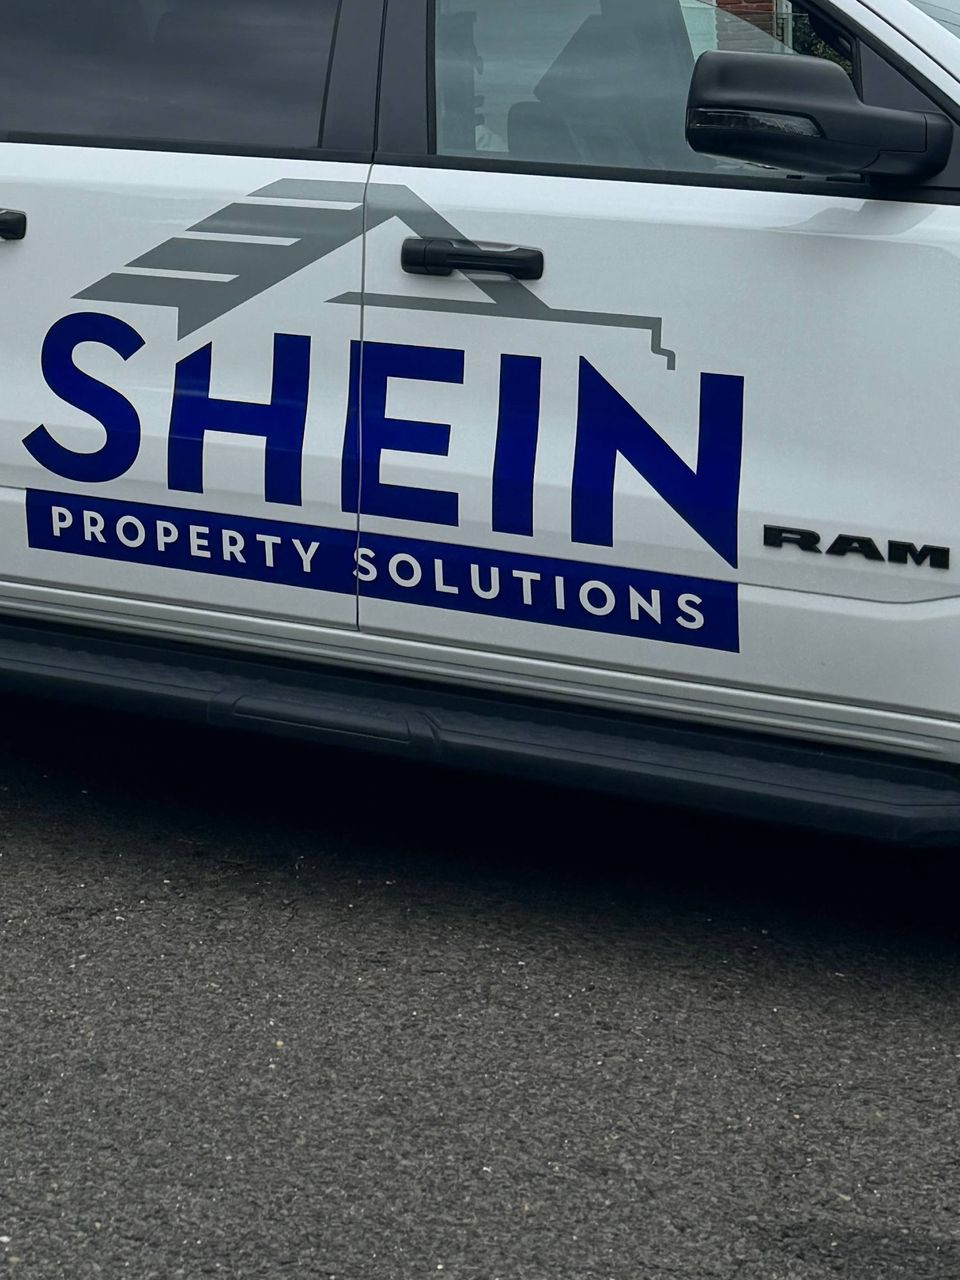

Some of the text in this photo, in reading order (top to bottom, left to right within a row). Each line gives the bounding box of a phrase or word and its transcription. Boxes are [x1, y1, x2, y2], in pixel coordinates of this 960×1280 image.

[22, 312, 745, 570] SHEIN
[51, 506, 705, 630] PROPERTY SOLUTIONS
[763, 524, 950, 570] RAM
